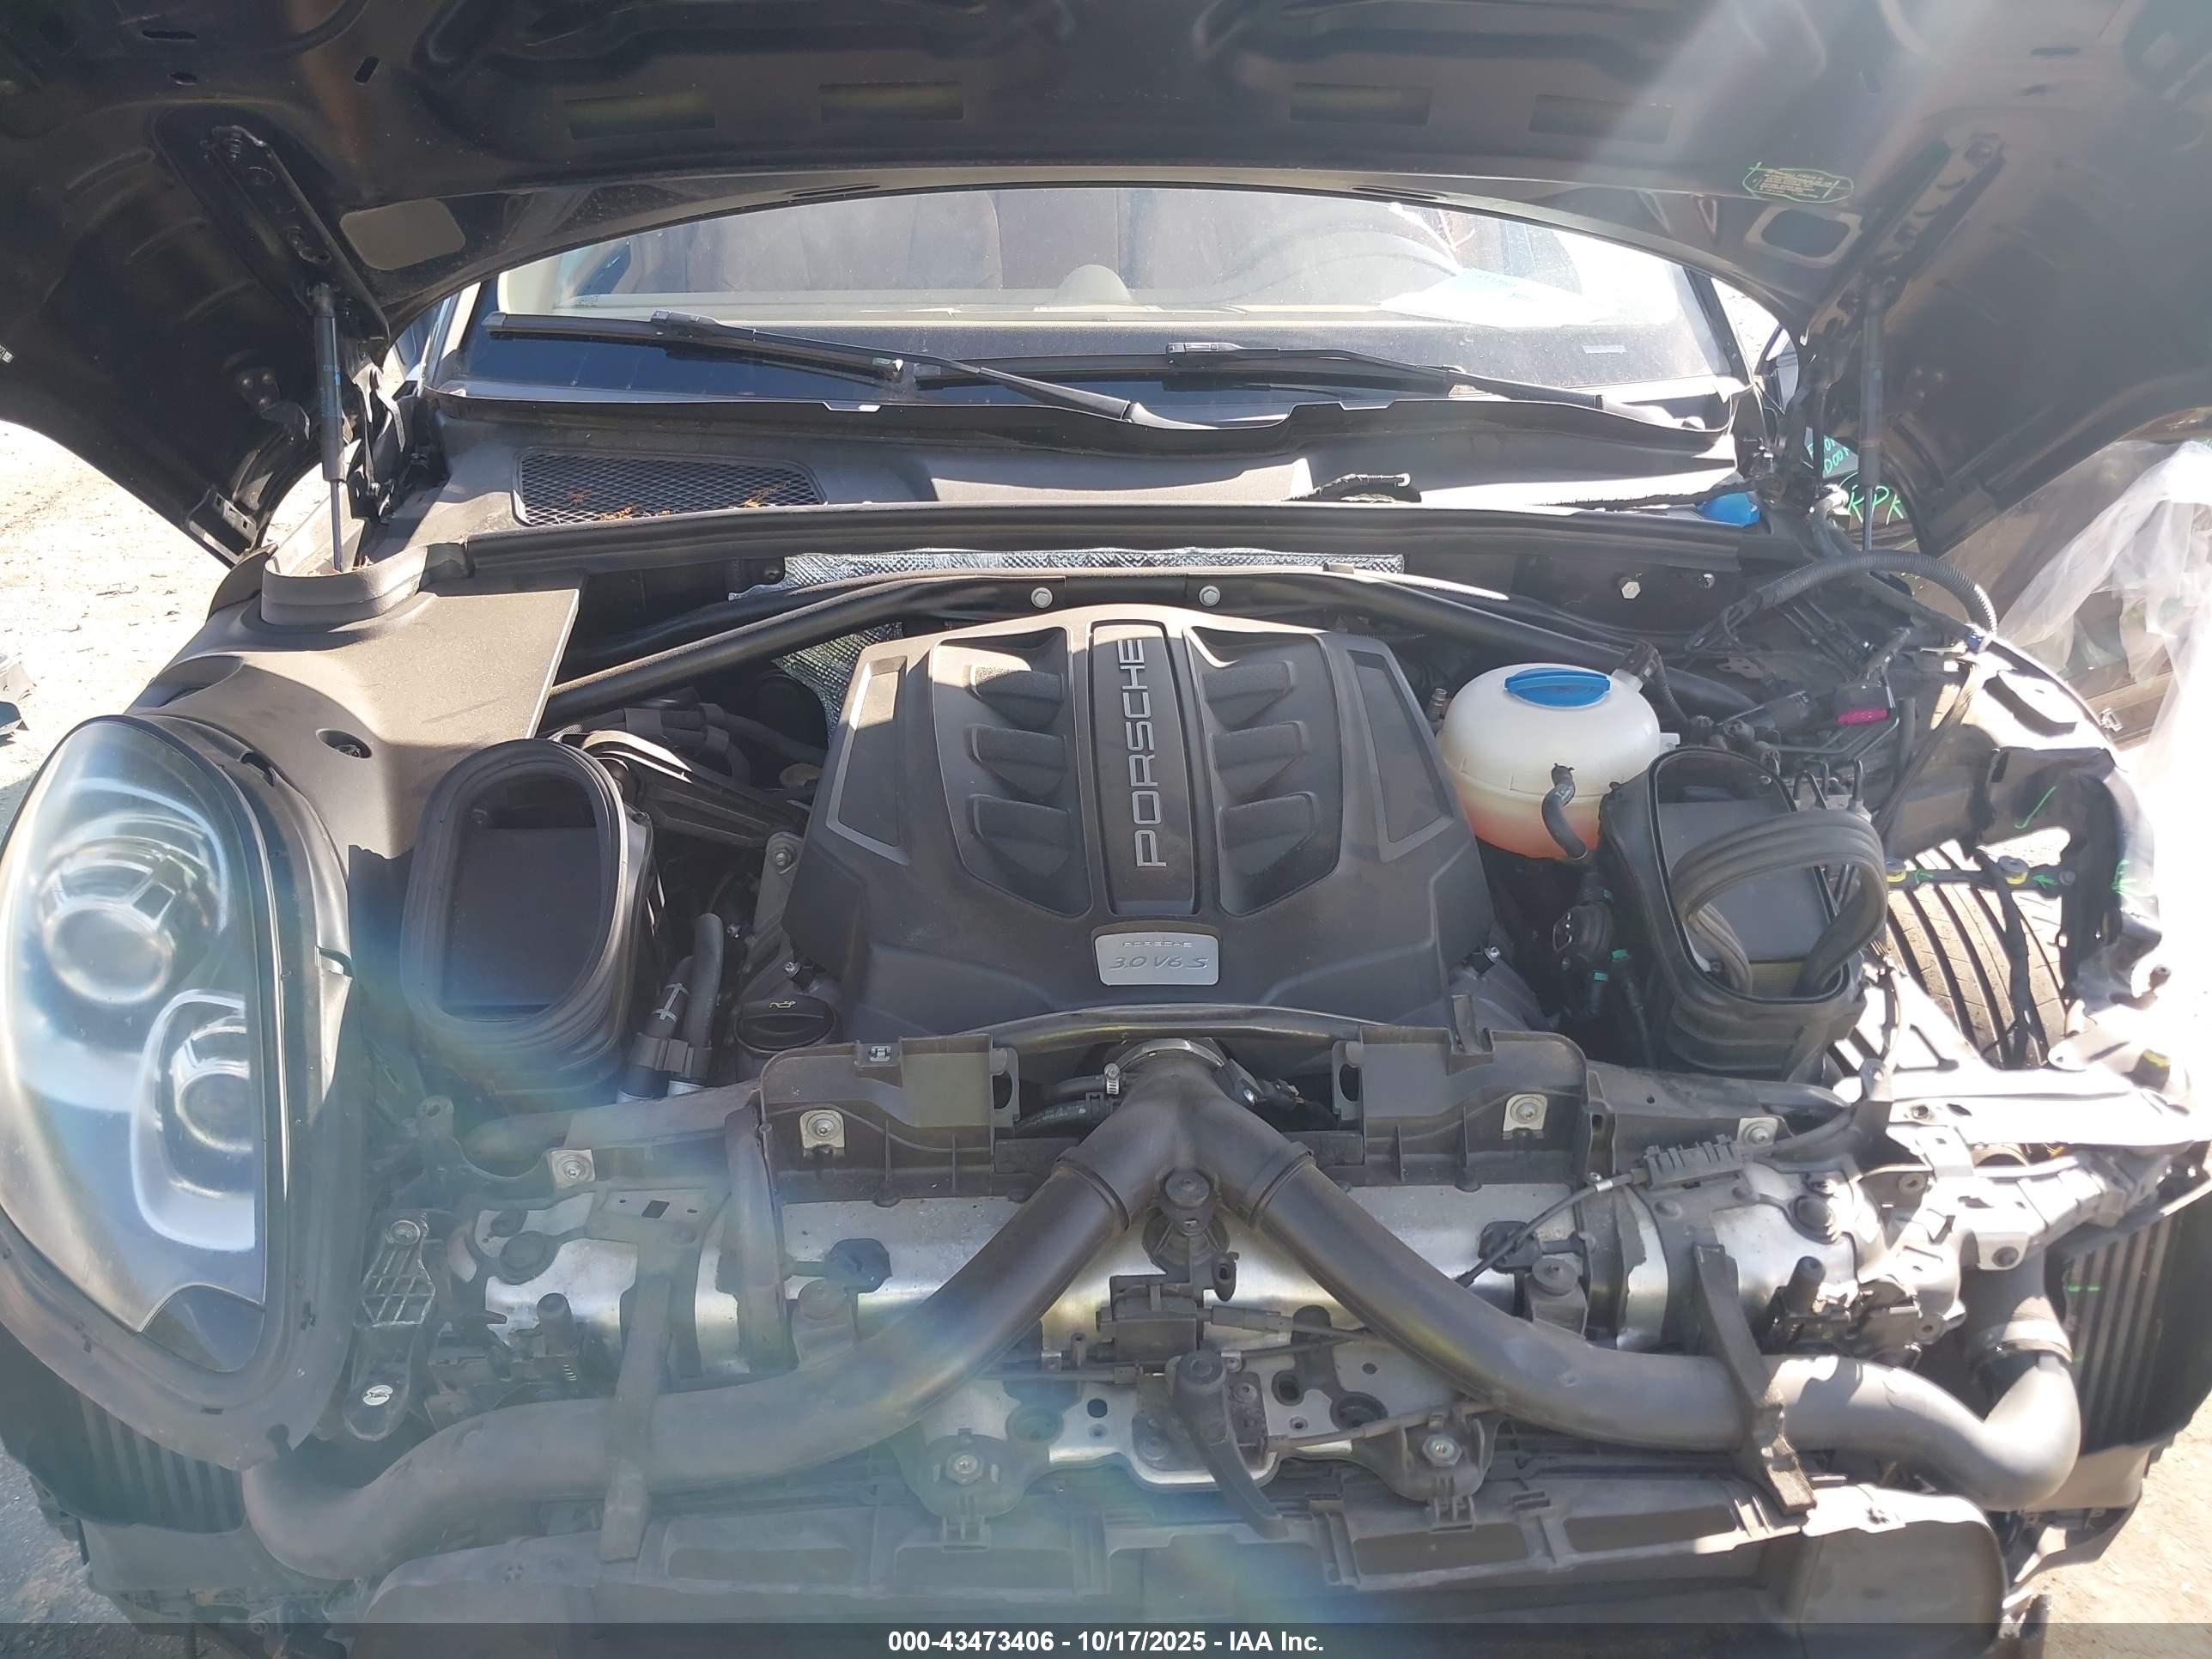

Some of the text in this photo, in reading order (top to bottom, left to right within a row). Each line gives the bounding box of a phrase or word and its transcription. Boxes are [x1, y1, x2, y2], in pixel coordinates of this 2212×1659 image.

[1117, 638, 1167, 867] PORSCHE
[1109, 955, 1209, 969] 3.0 V6 S
